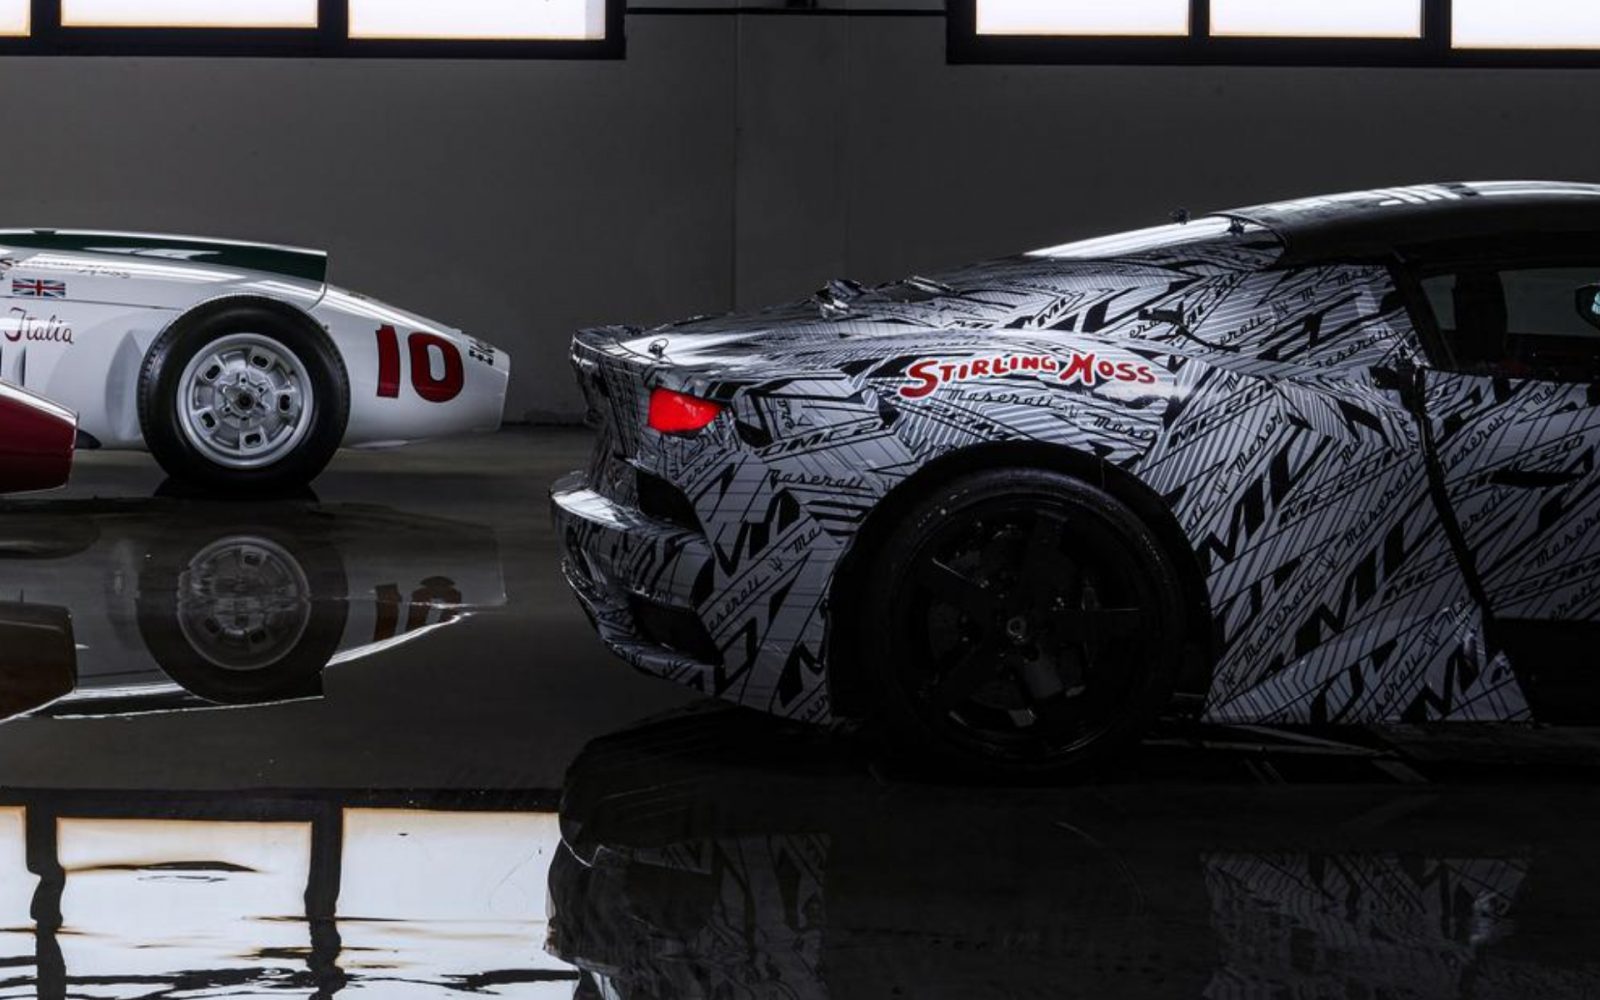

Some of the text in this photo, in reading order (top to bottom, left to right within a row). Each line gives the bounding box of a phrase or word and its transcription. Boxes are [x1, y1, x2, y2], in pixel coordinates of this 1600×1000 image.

[4, 306, 74, 345] Italia
[376, 324, 464, 403] 10
[899, 352, 1156, 398] STIRLING MOSS
